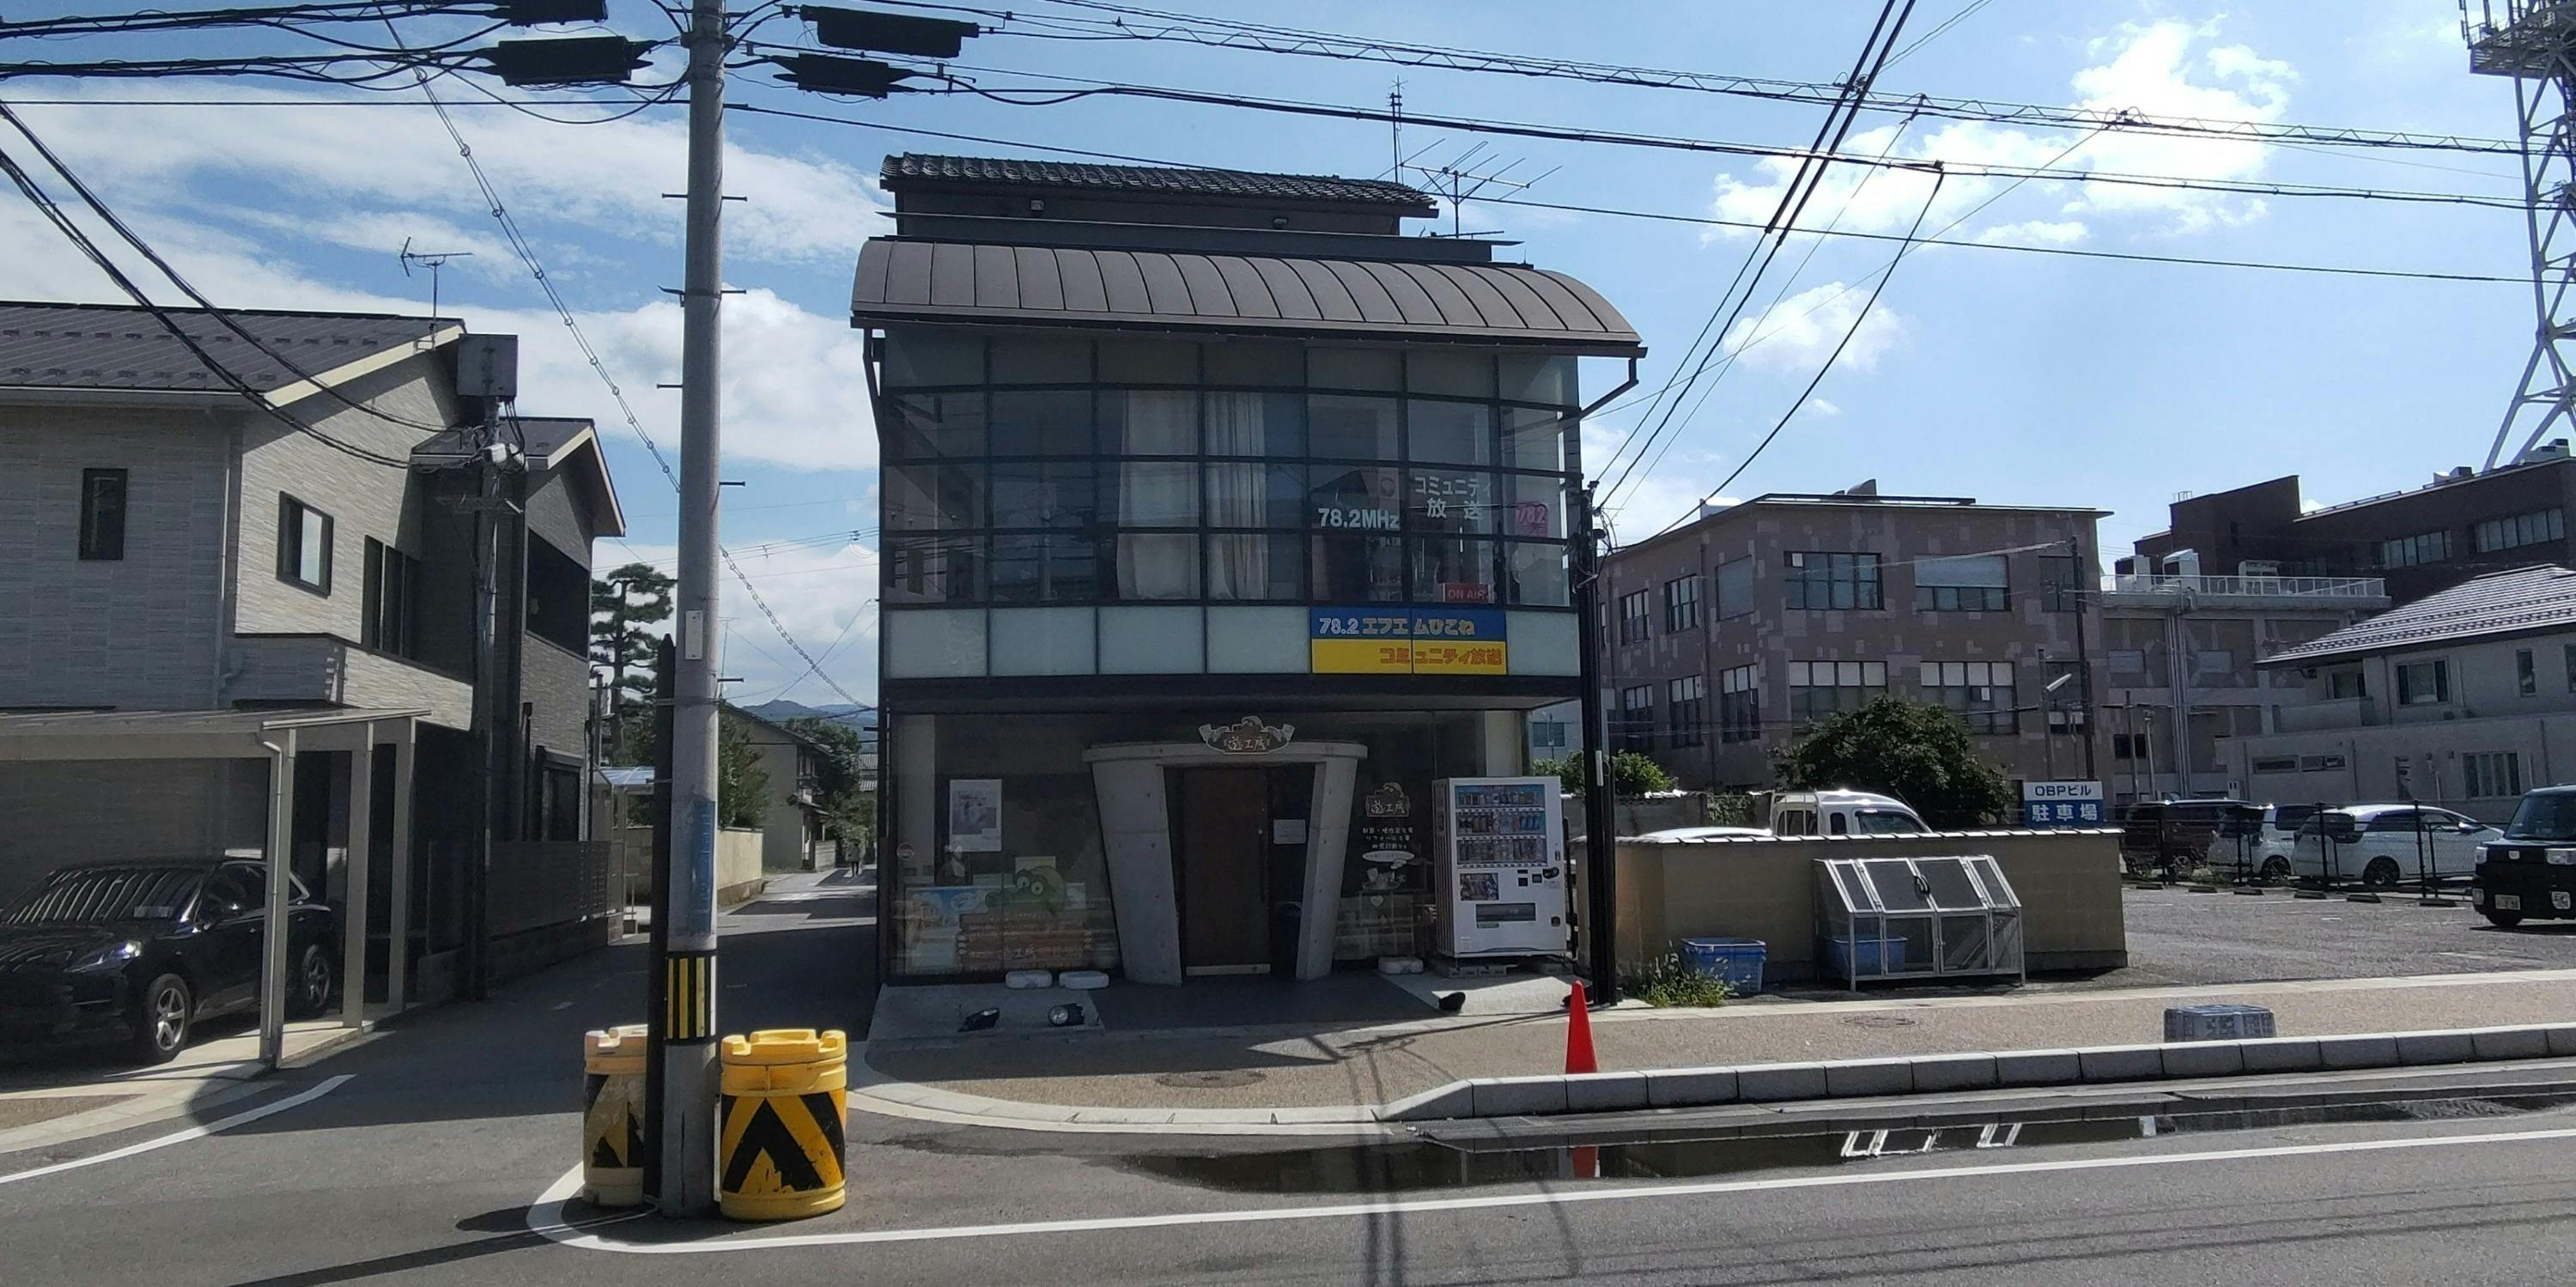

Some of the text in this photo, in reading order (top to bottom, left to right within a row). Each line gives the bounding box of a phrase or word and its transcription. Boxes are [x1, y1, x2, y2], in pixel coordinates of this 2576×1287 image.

[1414, 475, 1492, 497] コミュニティ
[1426, 497, 1483, 520] 放送
[1317, 507, 1400, 531] 78.2MHz
[1448, 589, 1485, 600] ON AIR
[1319, 617, 1475, 636] 78.2 エフエムひこね
[1379, 647, 1502, 666] コミュニティ放送
[2034, 785, 2092, 797] OBPビル
[2032, 803, 2098, 822] 駐車場
